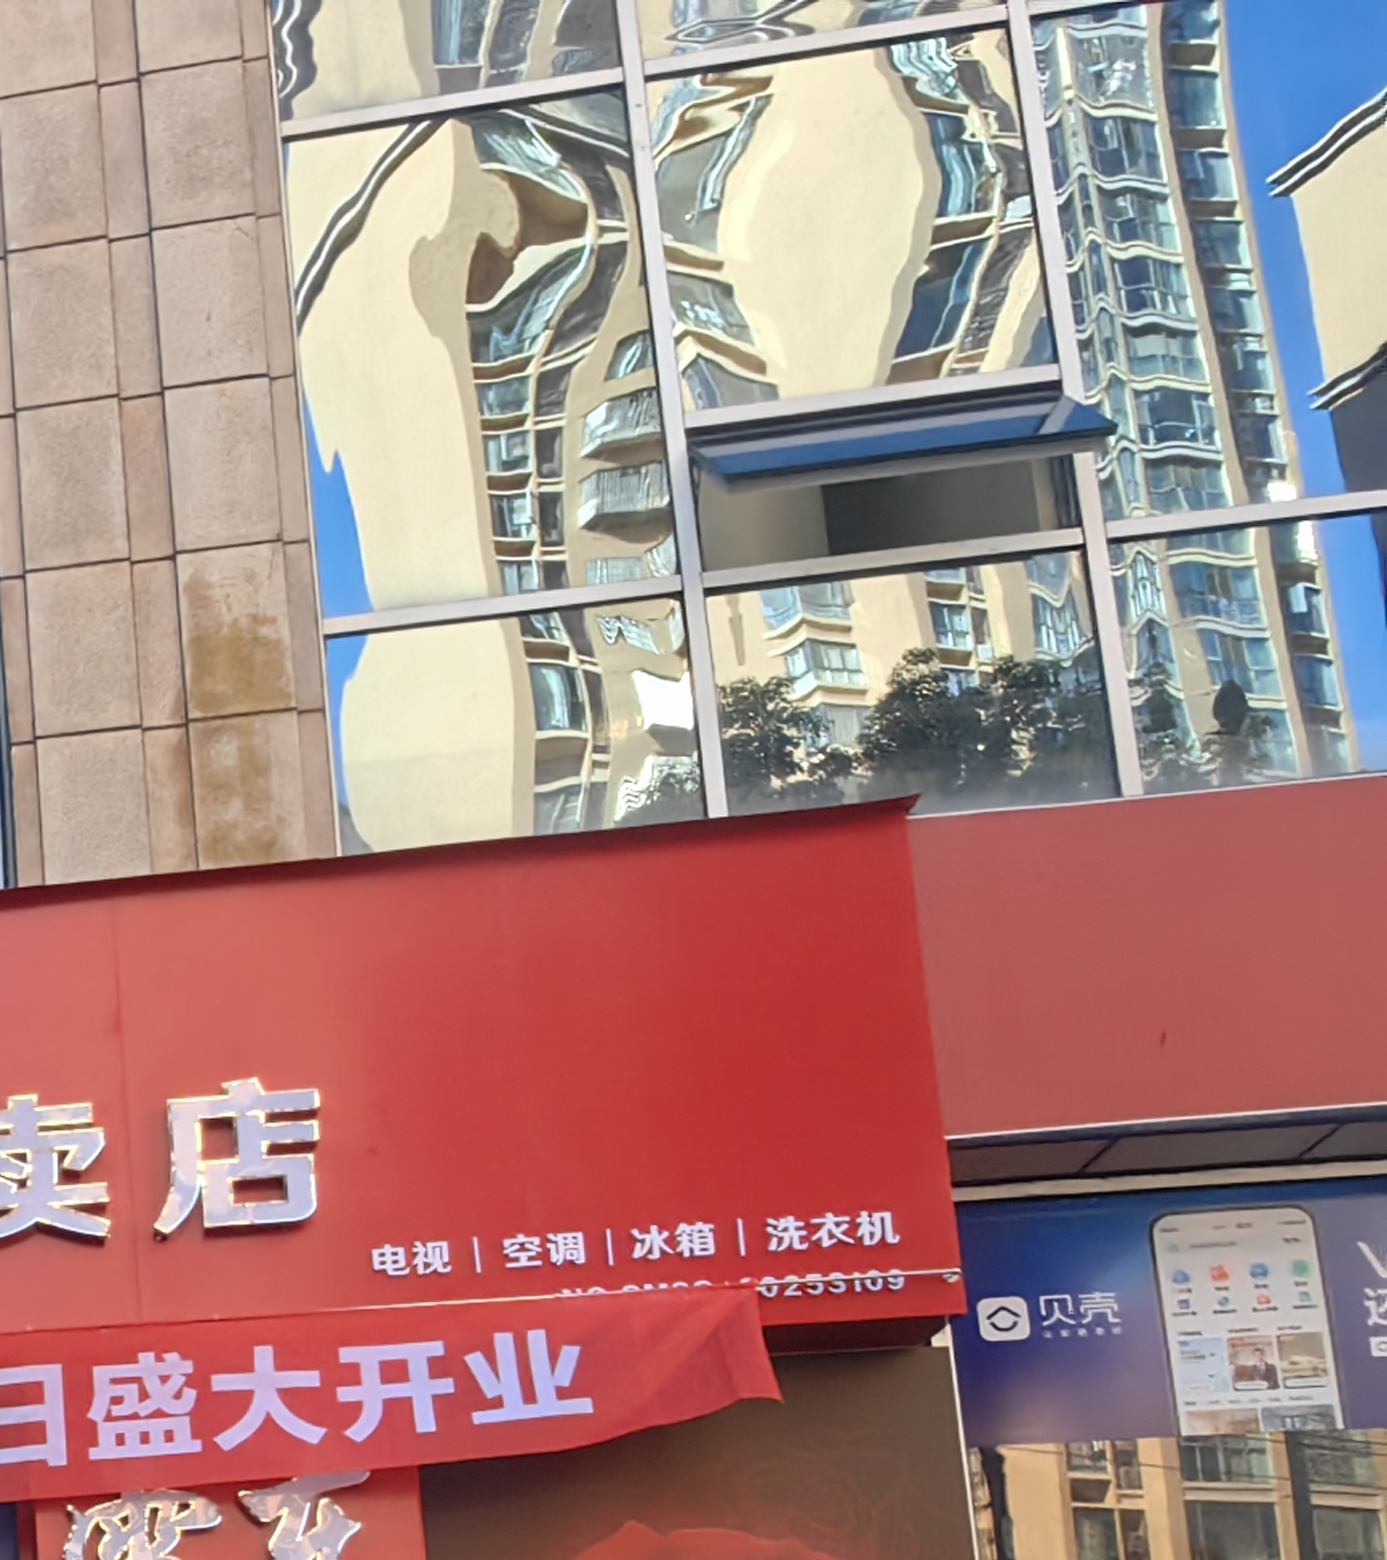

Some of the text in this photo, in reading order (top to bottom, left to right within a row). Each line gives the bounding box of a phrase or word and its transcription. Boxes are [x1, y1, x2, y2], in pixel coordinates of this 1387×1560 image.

[371, 1210, 901, 1276] 电视 空调 冰箱 洗衣机
[1038, 1291, 1122, 1327] 贝壳
